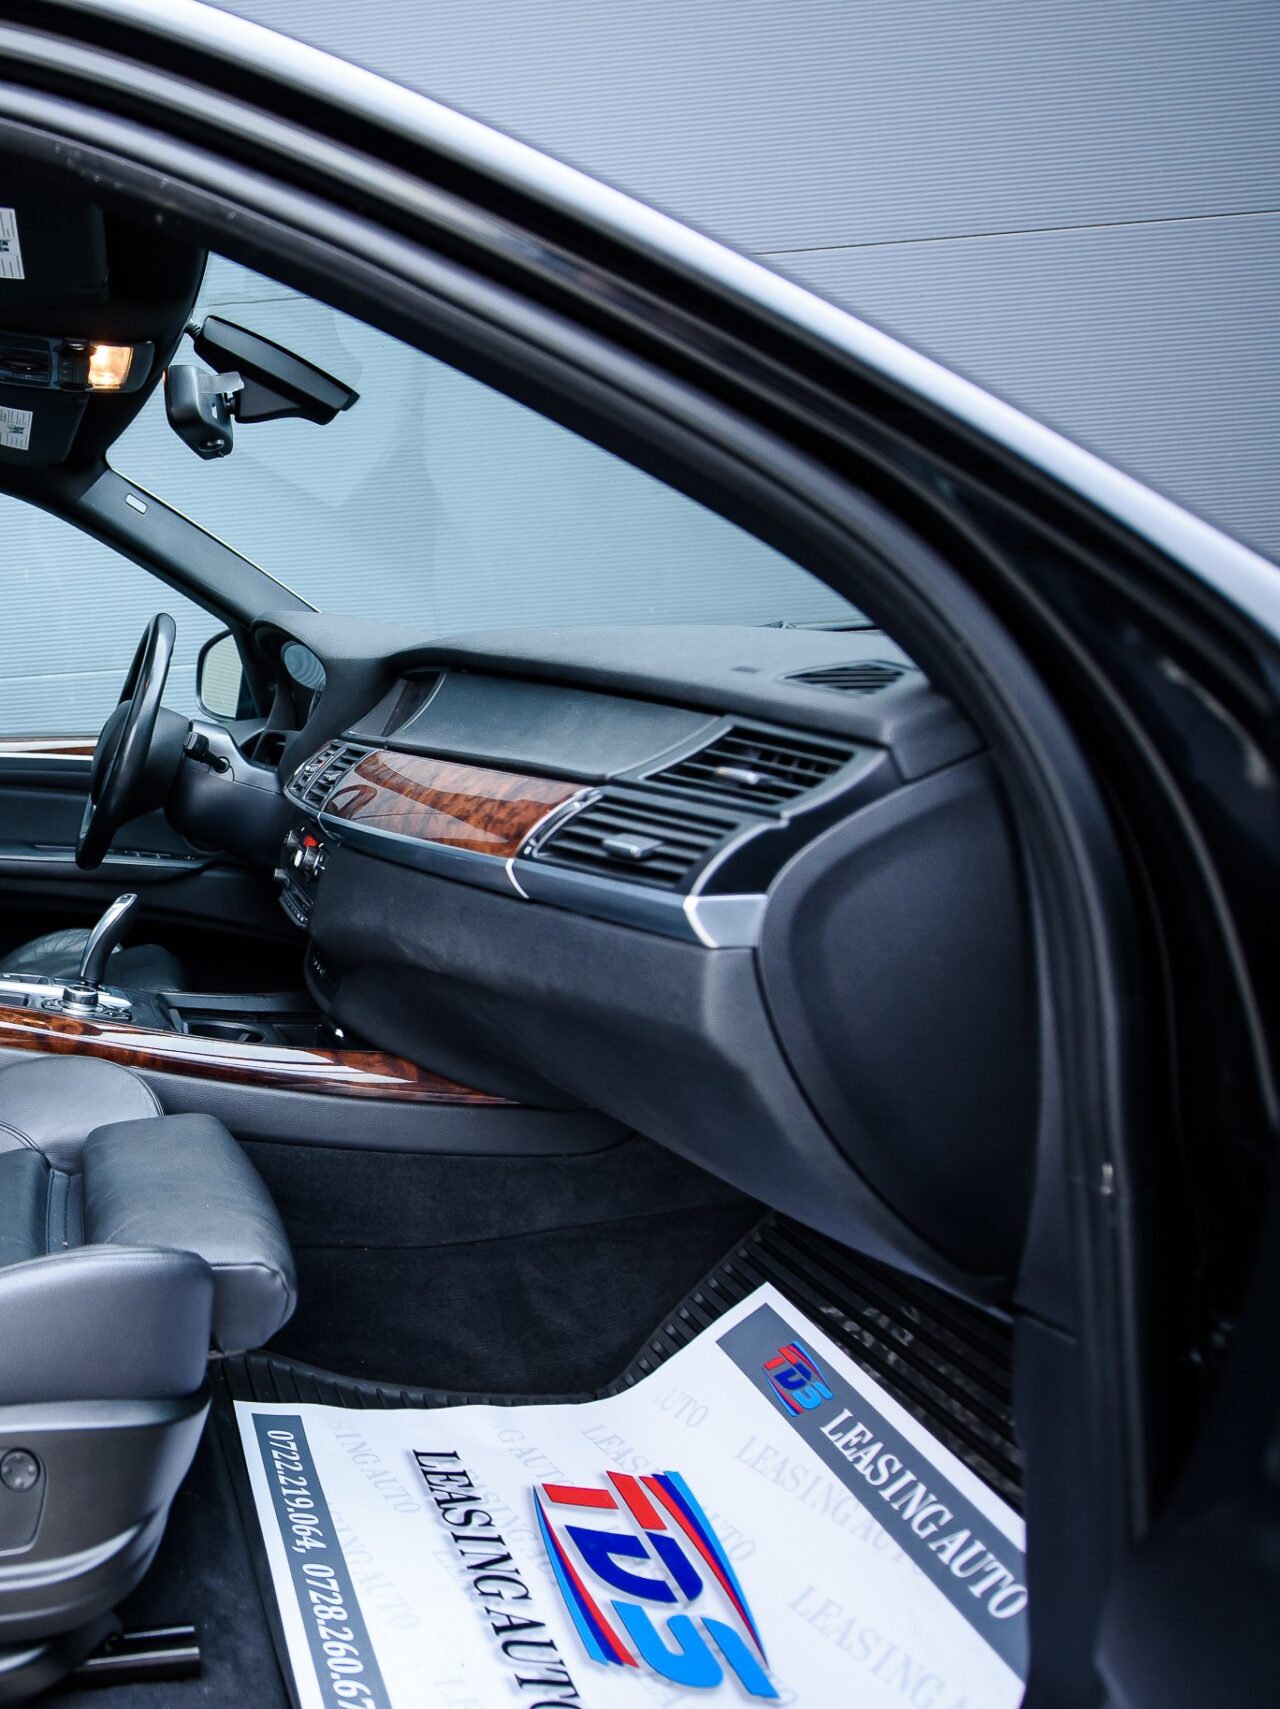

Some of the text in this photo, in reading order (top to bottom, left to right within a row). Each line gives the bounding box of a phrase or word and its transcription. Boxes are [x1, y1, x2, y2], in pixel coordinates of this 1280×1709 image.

[764, 1343, 834, 1409] TDS
[267, 1429, 328, 1555] 0722.219.064,
[413, 1449, 582, 1709] LEASINGAUT
[540, 1471, 780, 1699] TDS
